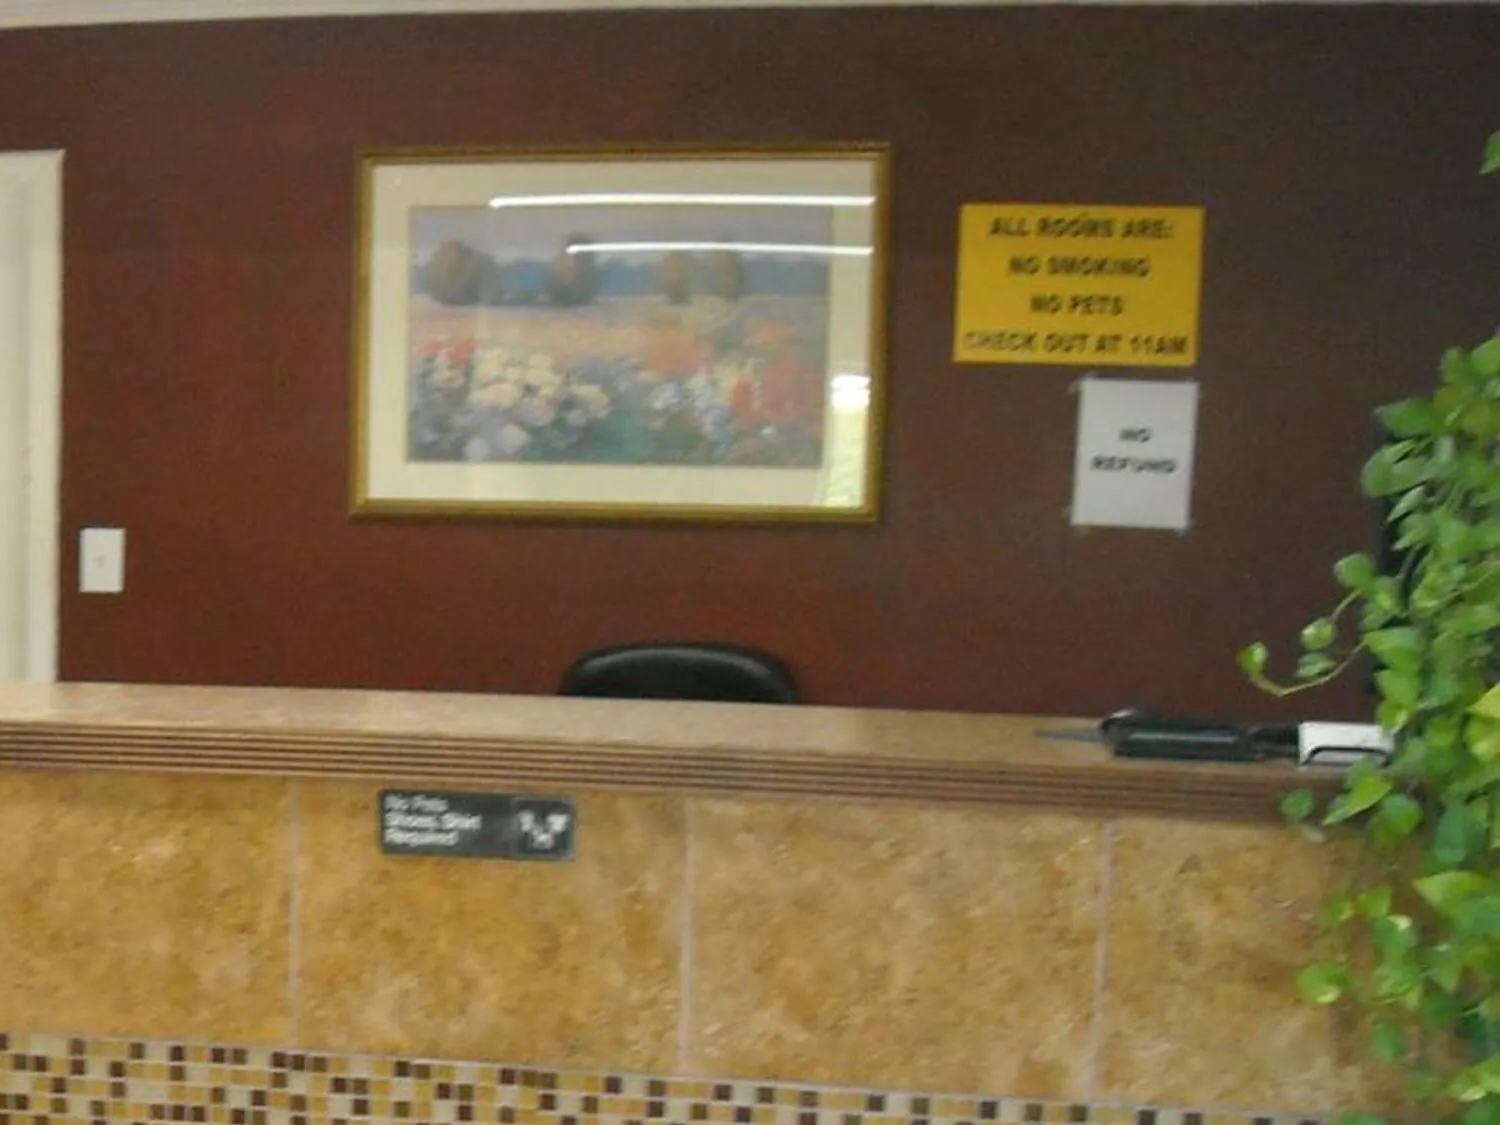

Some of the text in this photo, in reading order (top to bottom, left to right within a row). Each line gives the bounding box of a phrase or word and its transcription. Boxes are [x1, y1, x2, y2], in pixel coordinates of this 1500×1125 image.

[988, 217, 1030, 238] ALL
[1008, 255, 1151, 278] NO SMOKING
[1030, 294, 1125, 316] NO PETS
[964, 331, 1037, 352] CHECK
[1044, 333, 1089, 353] OUT
[1094, 334, 1122, 353] AT
[1119, 427, 1152, 444] NO
[1090, 455, 1177, 474] REFUND
